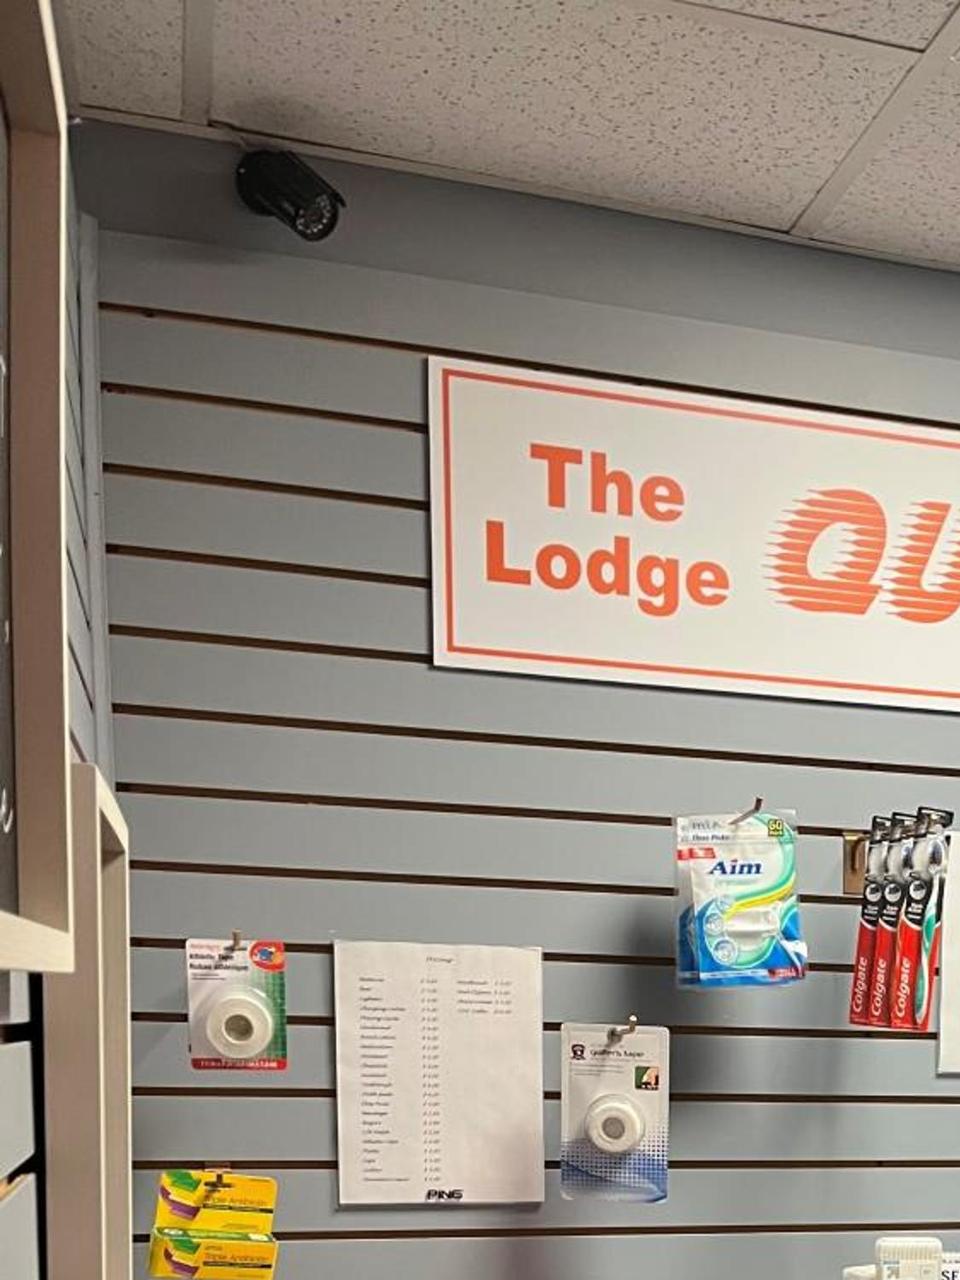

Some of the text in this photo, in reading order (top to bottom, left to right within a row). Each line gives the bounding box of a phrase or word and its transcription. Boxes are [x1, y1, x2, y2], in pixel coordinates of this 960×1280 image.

[530, 442, 685, 523] The
[485, 519, 730, 617] Lodge
[708, 860, 763, 875] Aim
[852, 956, 868, 1013] Colgate
[871, 960, 887, 1017] Colgate
[895, 958, 912, 1018] Colgate
[426, 1189, 464, 1201] PING
